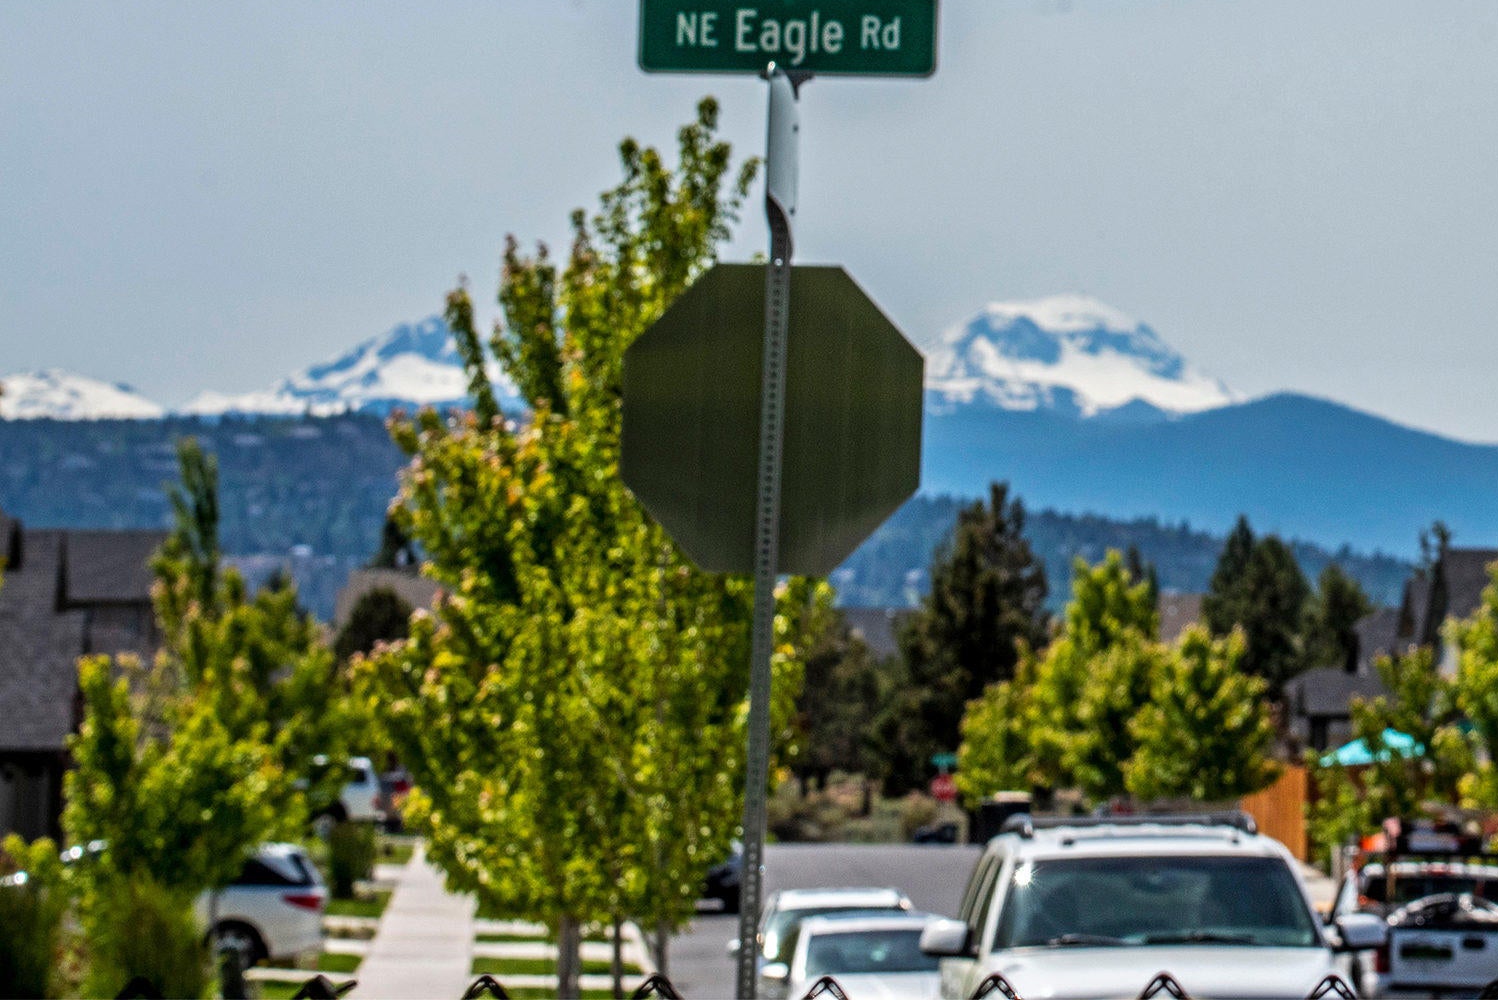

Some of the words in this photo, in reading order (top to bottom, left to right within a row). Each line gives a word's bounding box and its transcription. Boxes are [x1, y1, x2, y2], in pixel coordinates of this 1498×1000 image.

[676, 11, 718, 46] NE
[735, 9, 844, 65] Eagle
[860, 15, 901, 50] Rd
